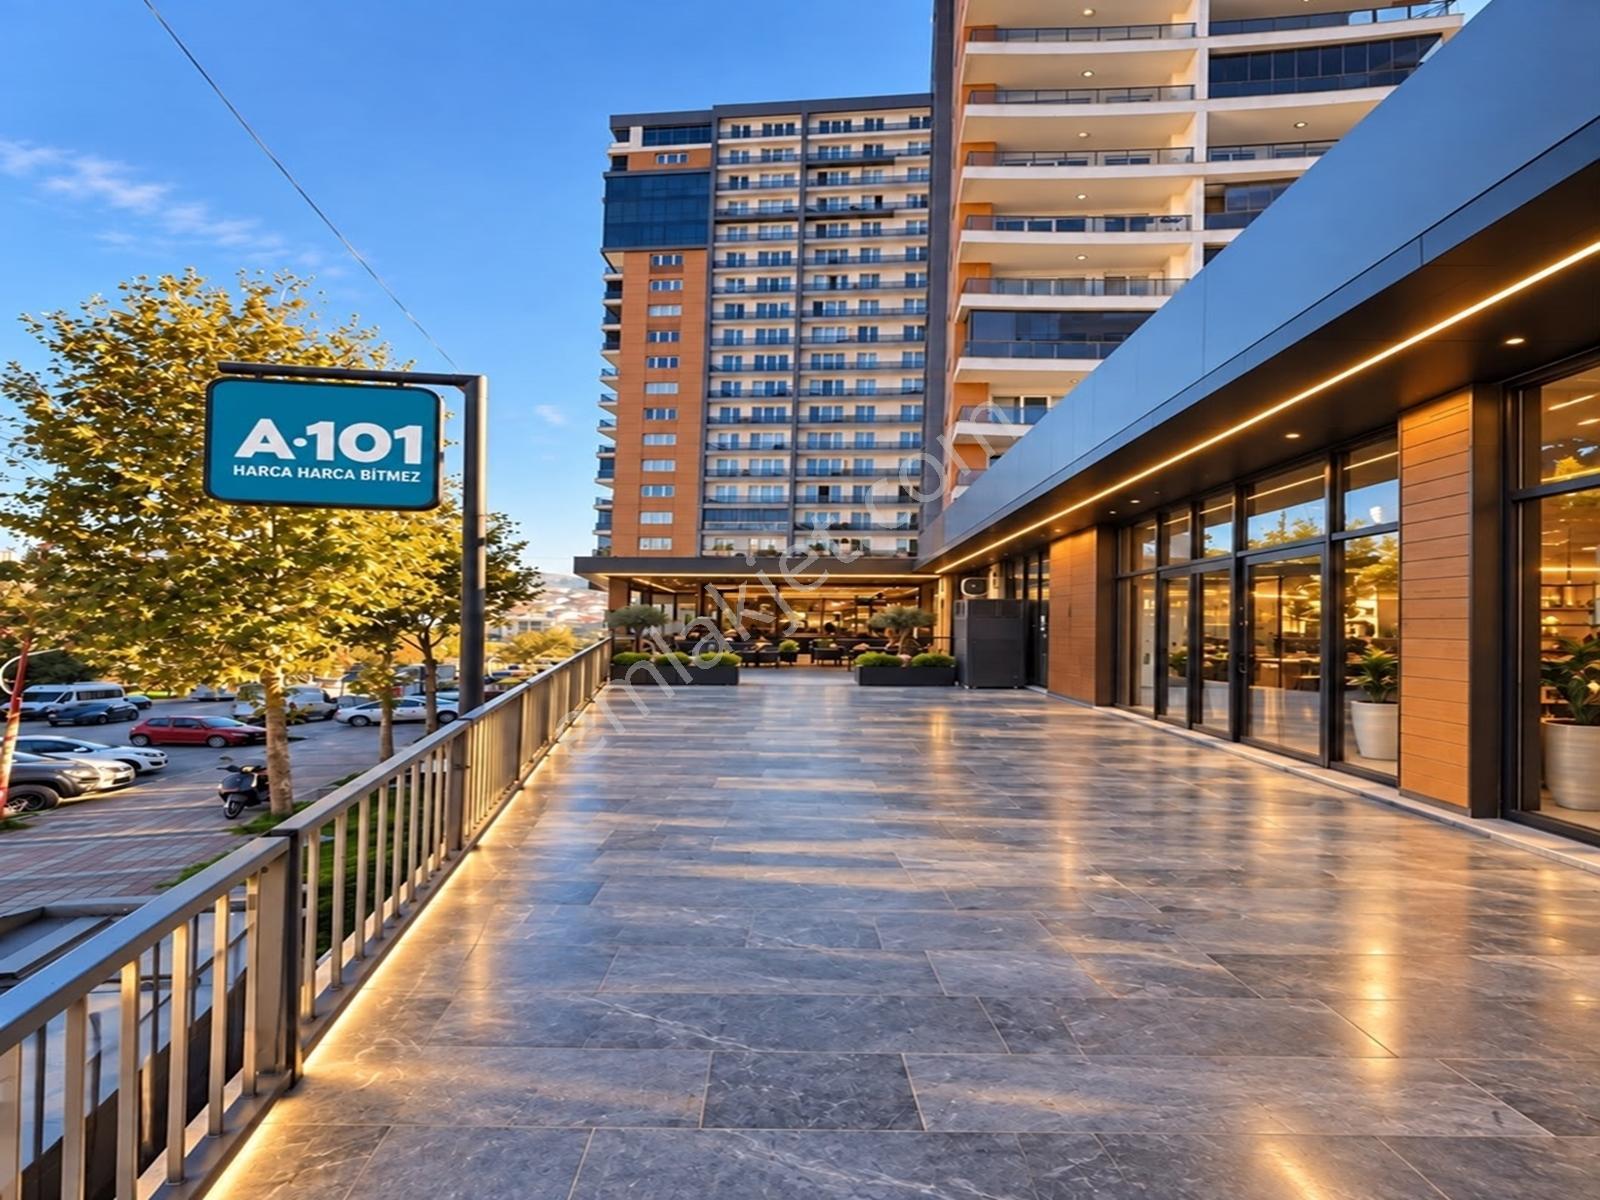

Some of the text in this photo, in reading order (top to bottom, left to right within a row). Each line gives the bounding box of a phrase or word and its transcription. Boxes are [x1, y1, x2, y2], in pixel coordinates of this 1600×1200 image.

[233, 464, 420, 483] HARCA HARCA BİTMEZ
